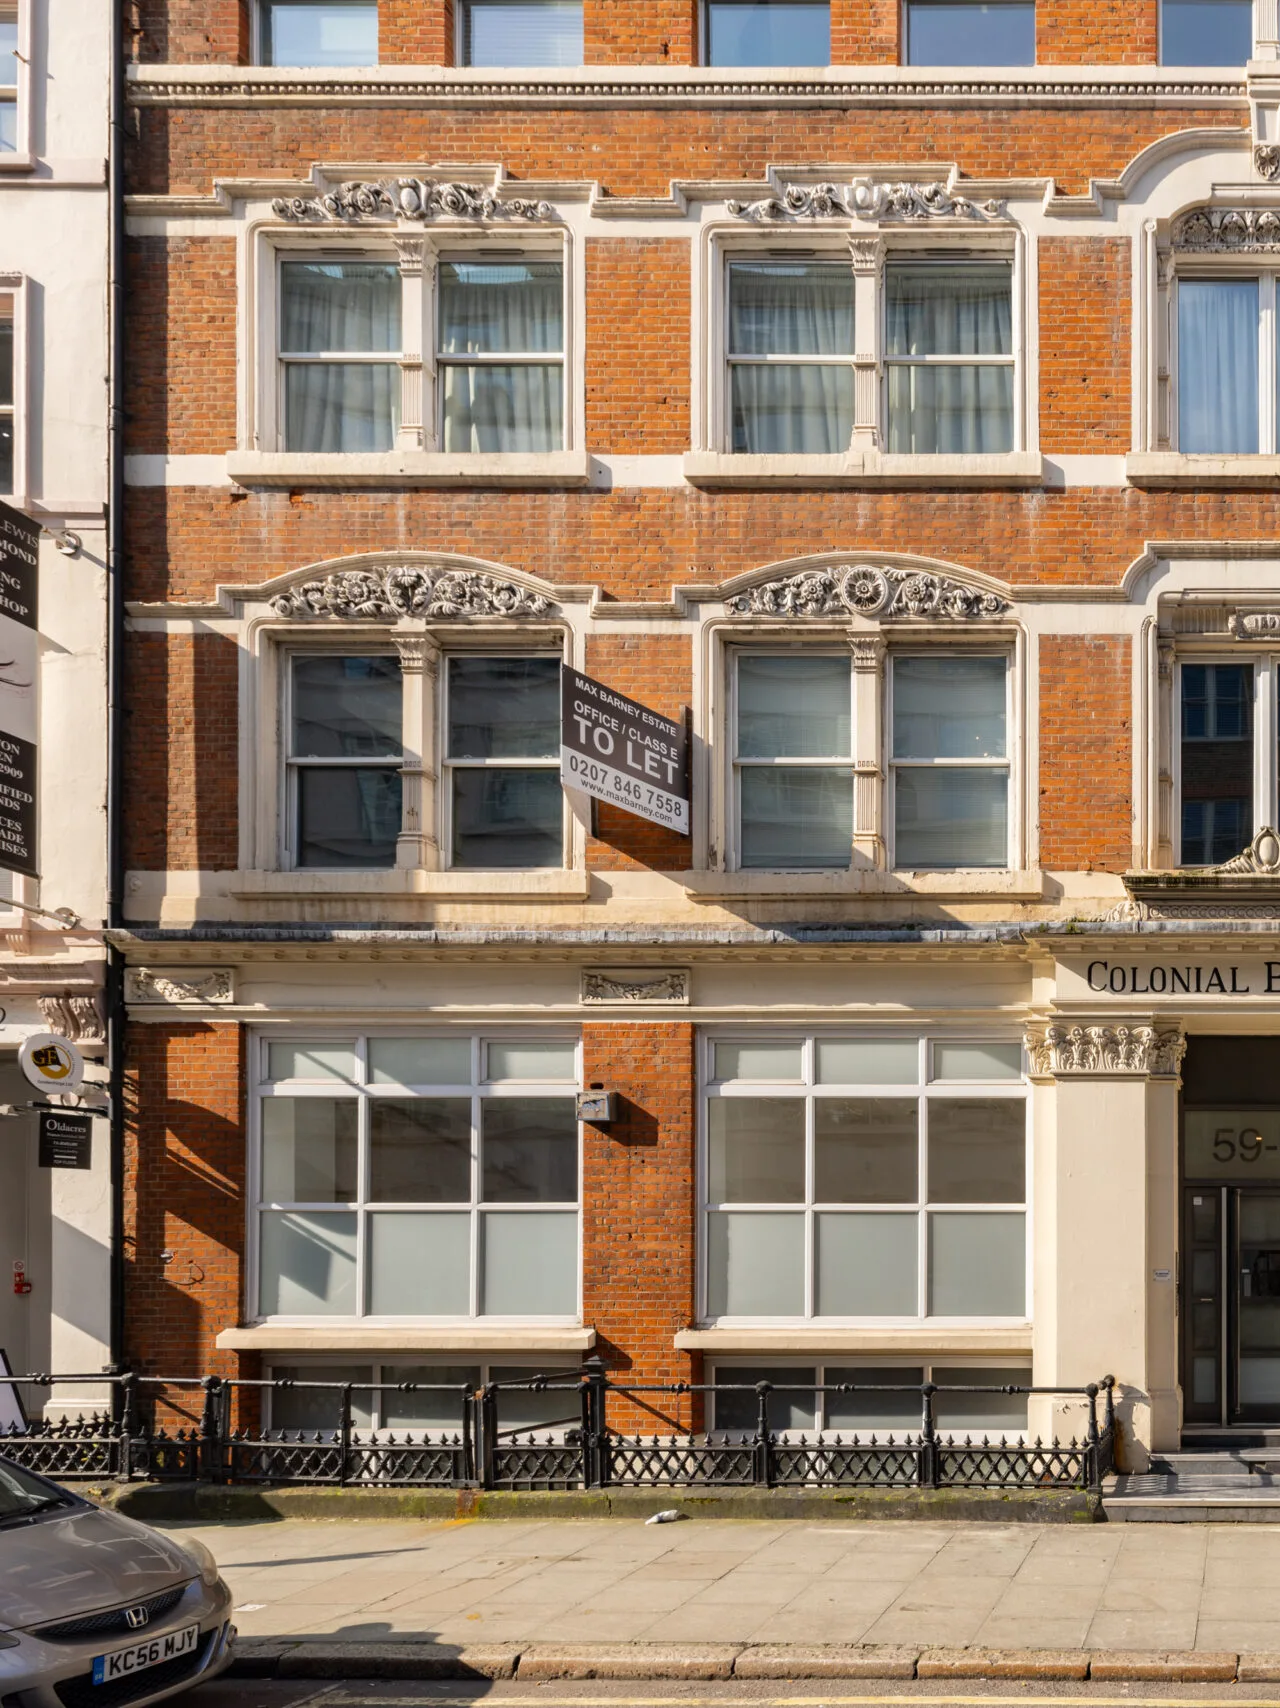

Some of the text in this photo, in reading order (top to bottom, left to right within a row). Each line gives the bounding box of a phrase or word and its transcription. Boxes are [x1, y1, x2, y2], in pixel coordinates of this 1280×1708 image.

[0, 520, 39, 549] EWIS
[574, 700, 678, 760] OFFICE / CLASS E
[575, 677, 677, 737] MAX BARNEY ESTATE
[0, 739, 20, 755] ON
[573, 714, 679, 785] TO LET
[570, 755, 682, 817] 0207 846 7558
[580, 778, 673, 824] www.maxbarney.com
[0, 841, 28, 858] ISES
[1087, 961, 1250, 993] COLONIAL
[46, 1119, 87, 1133] Oldacres
[109, 1628, 195, 1676] KC56 MJY
